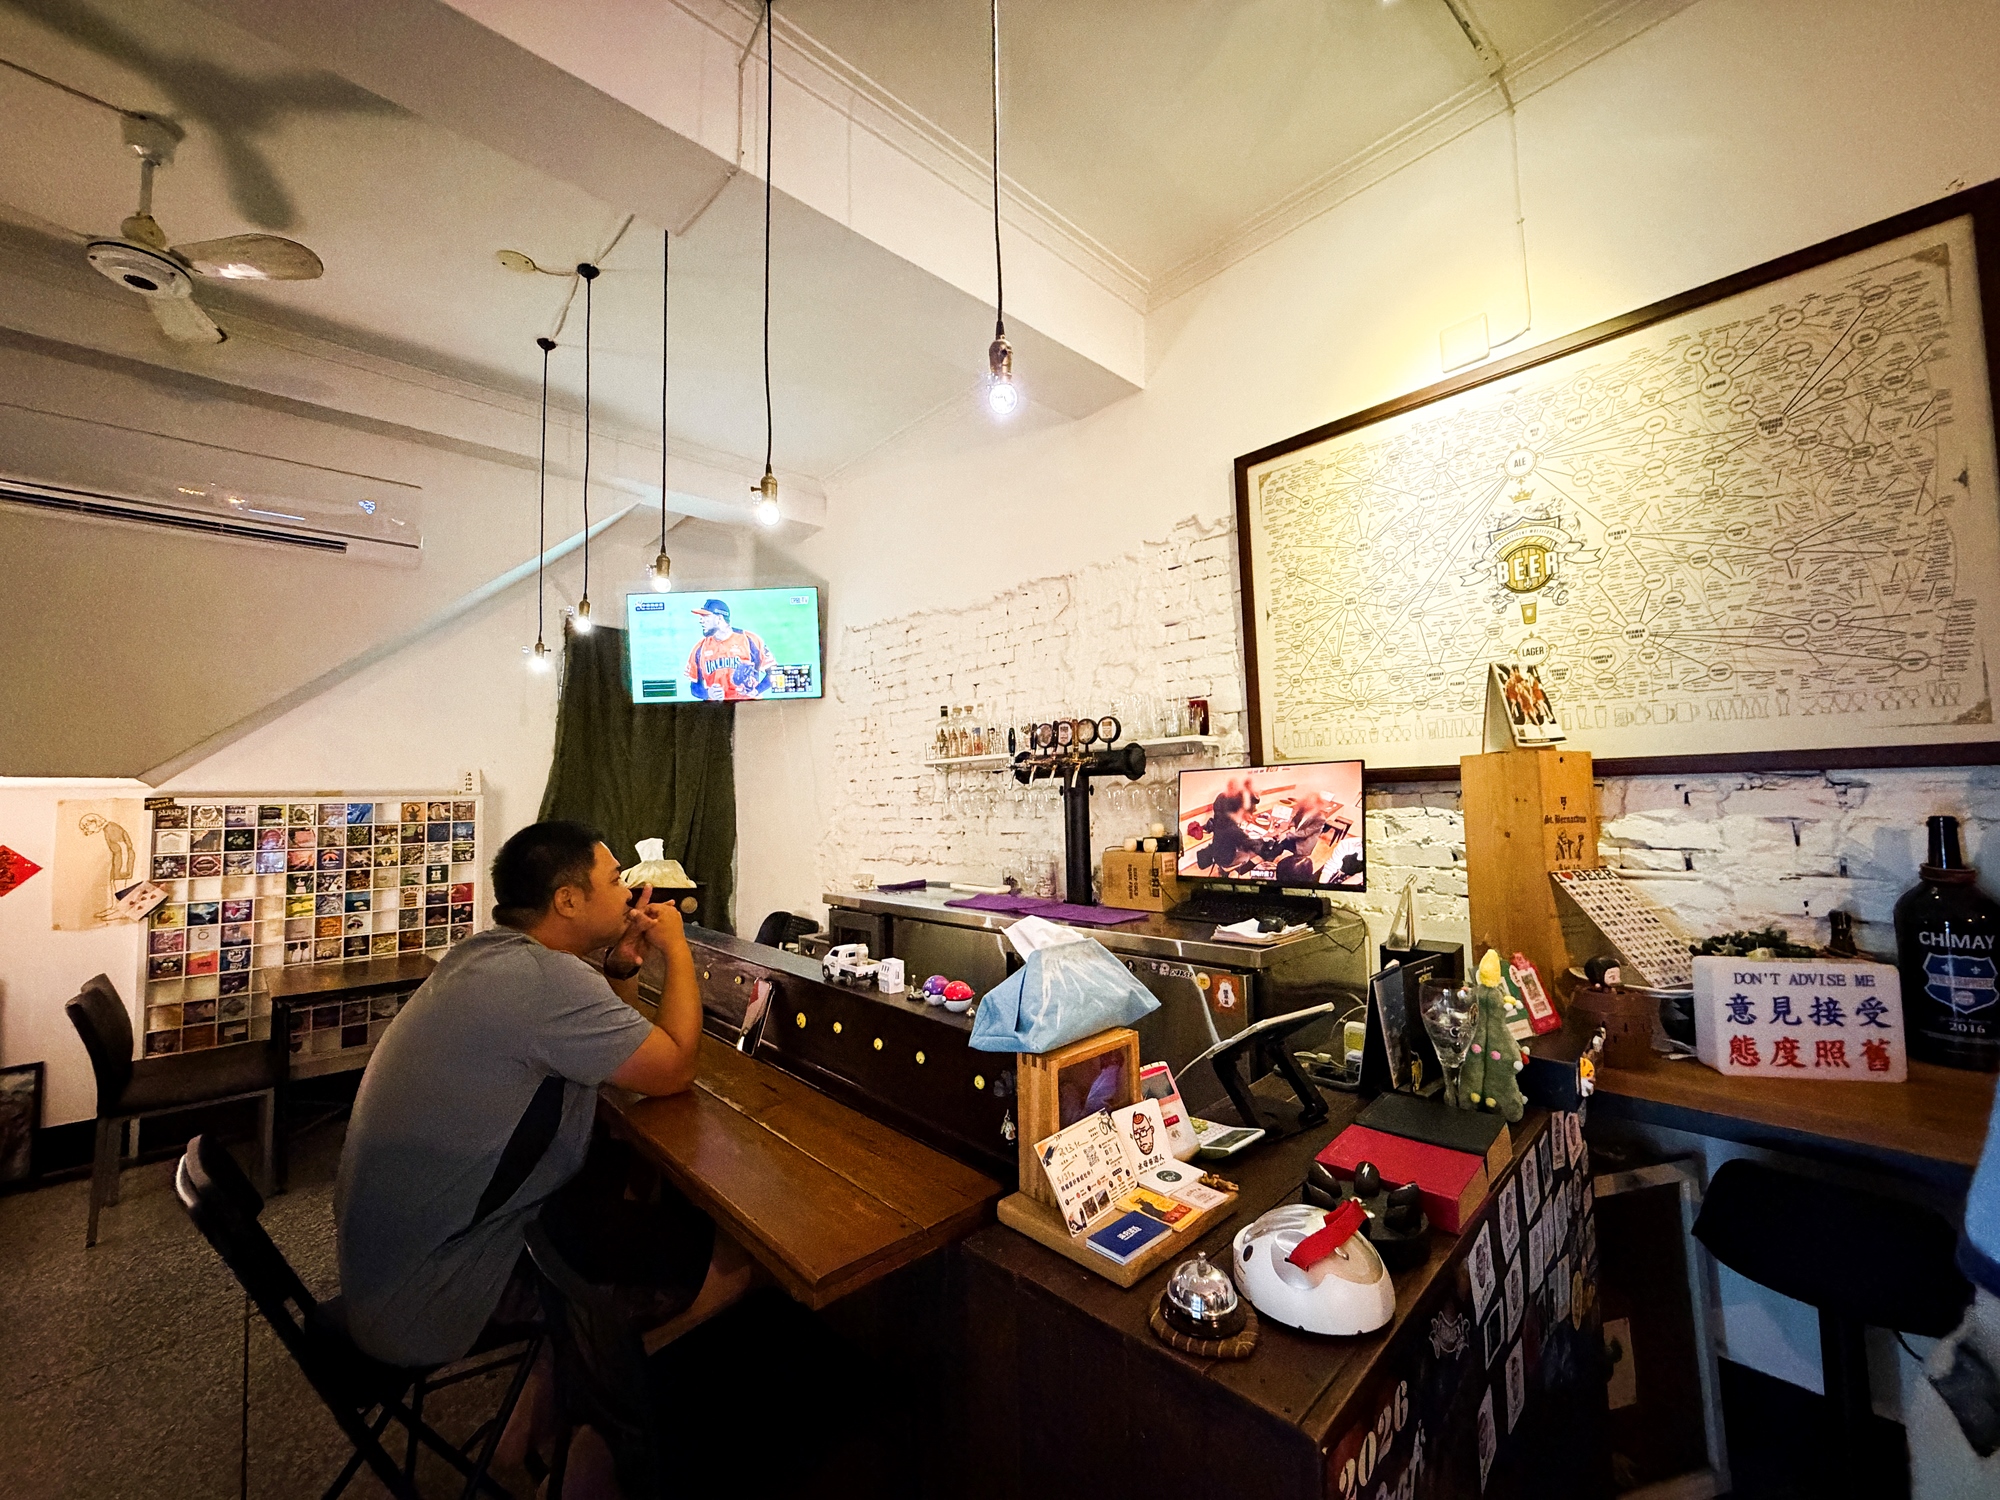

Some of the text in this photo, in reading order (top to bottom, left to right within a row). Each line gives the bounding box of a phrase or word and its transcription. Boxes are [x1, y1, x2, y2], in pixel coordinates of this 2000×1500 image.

[1514, 457, 1526, 468] ALE
[1608, 529, 1627, 537] GERMAN
[1496, 551, 1559, 584] BEER
[1522, 646, 1545, 657] LAGER
[1551, 869, 1618, 883] I BEER
[1919, 931, 1995, 949] CHIMAY
[1734, 973, 1875, 987] DON'T ADVISE ME
[1725, 993, 1892, 1028] 意見接受
[1949, 1022, 1985, 1033] 2016
[1729, 1035, 1891, 1072] 態度照舊
[1339, 1380, 1408, 1500] 2026
